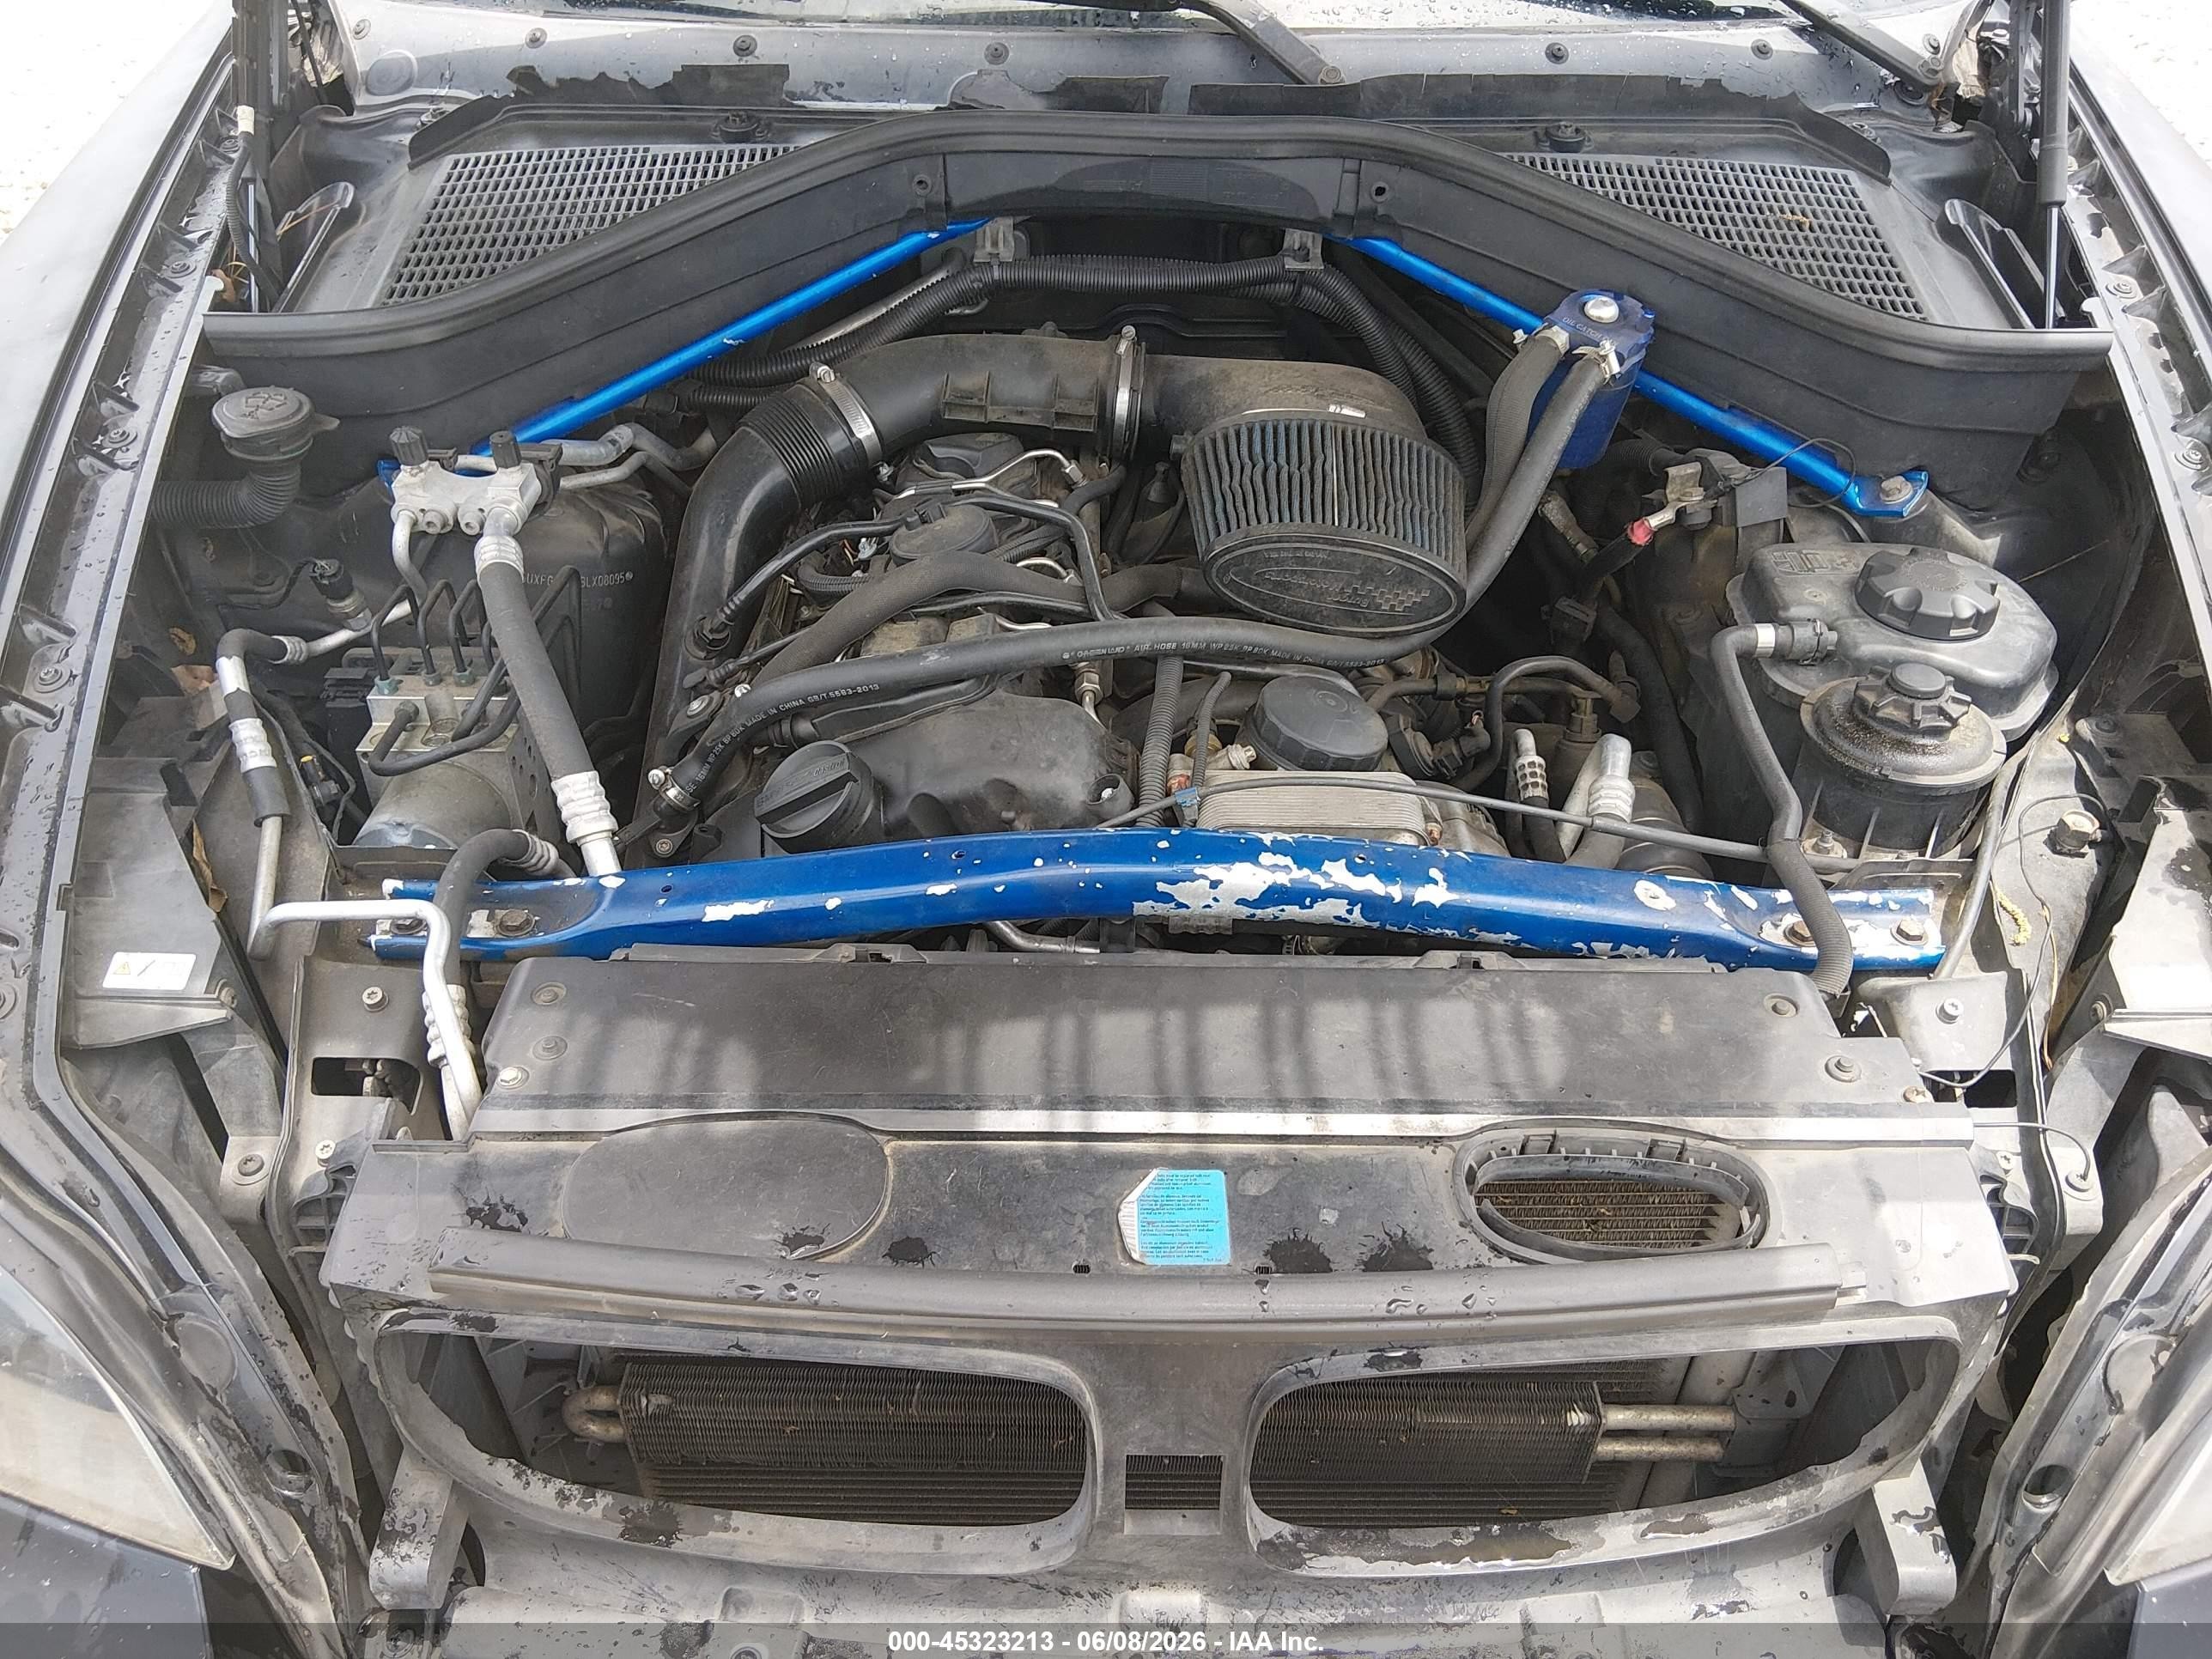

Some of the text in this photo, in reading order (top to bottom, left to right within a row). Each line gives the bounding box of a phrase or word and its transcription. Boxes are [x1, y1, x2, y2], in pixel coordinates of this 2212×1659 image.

[745, 712, 768, 728] MADE
[767, 706, 778, 717] IN
[778, 697, 806, 713] CHINA
